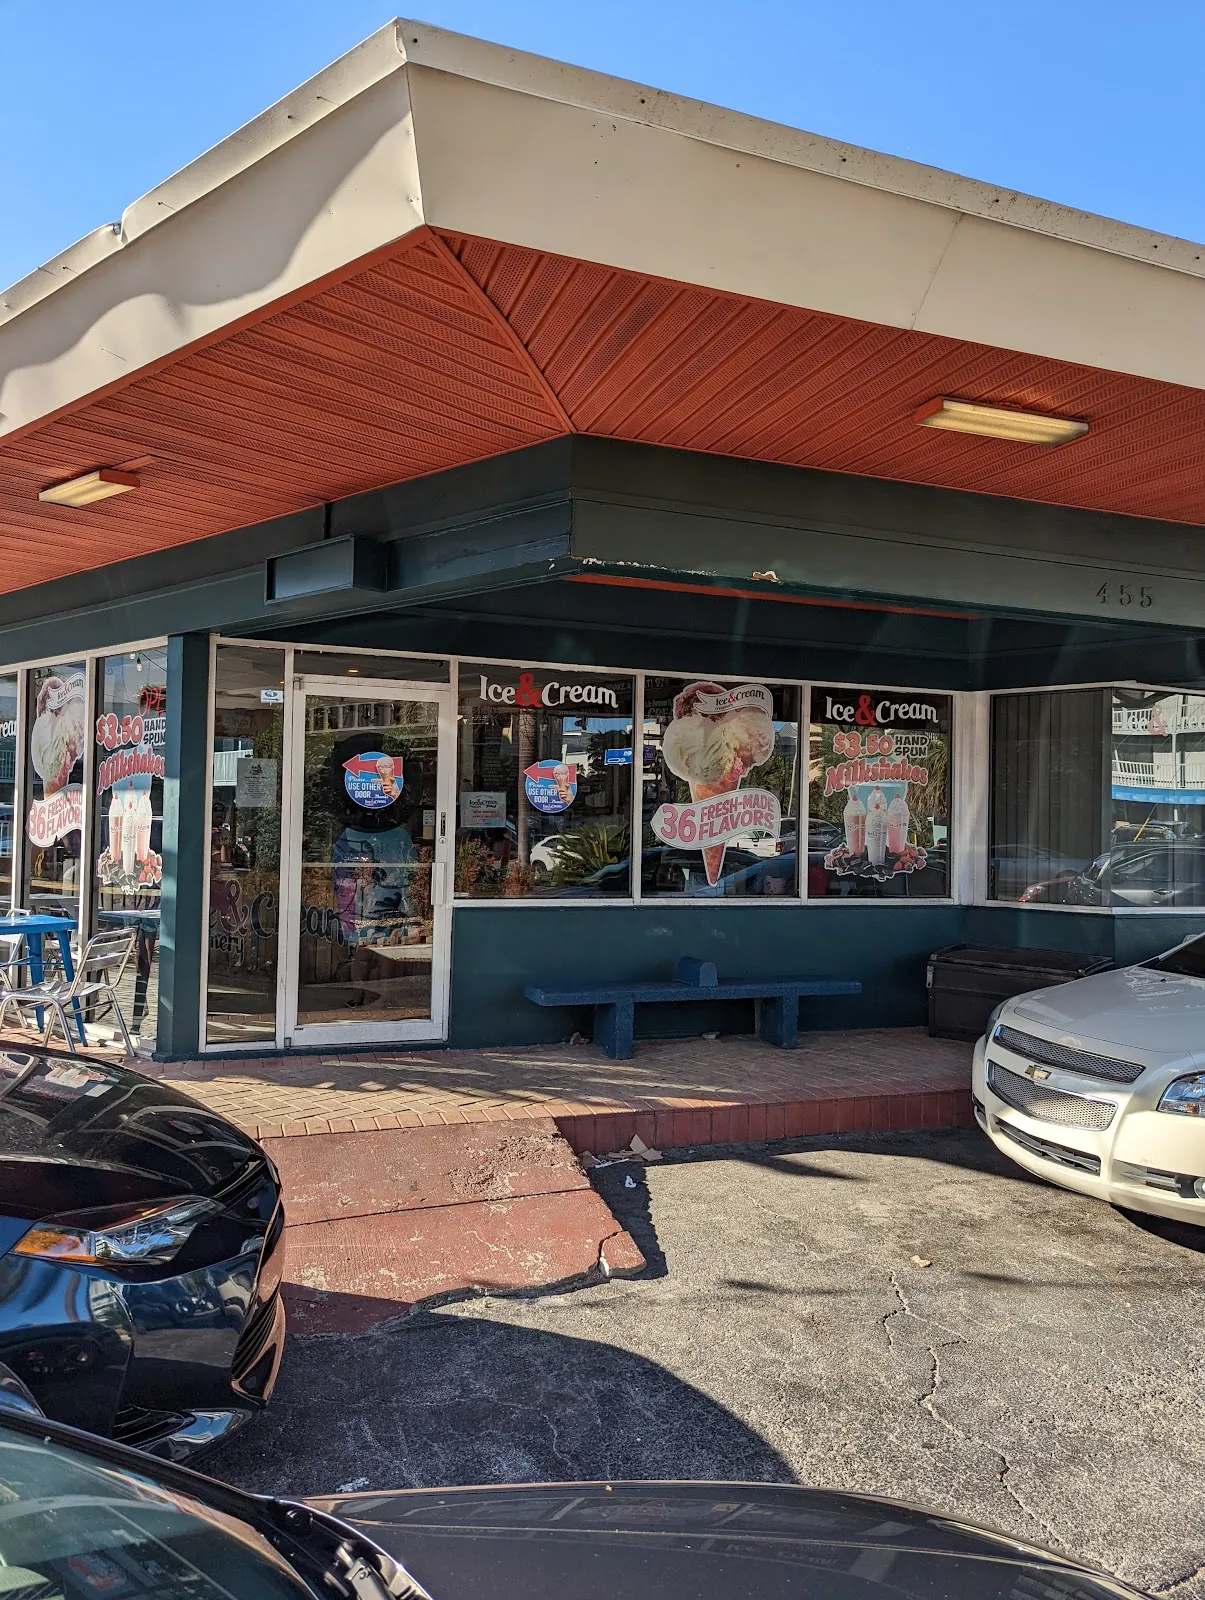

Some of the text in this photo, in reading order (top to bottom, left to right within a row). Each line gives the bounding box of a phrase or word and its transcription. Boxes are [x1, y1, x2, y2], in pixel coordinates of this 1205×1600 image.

[1096, 582, 1153, 609] 455
[96, 713, 143, 752] $3.50
[144, 719, 166, 733] HAND
[833, 731, 894, 759] $3.50
[894, 746, 929, 757] SPUN
[895, 735, 930, 747] HAND
[348, 782, 381, 791] USE OTHER
[824, 757, 928, 797] Milkshakes
[528, 787, 557, 796] USE OTHER
[29, 805, 46, 840] 36
[701, 794, 773, 823] FRESH-MADE
[661, 805, 696, 842] 36
[699, 810, 774, 840] FLAVORS
